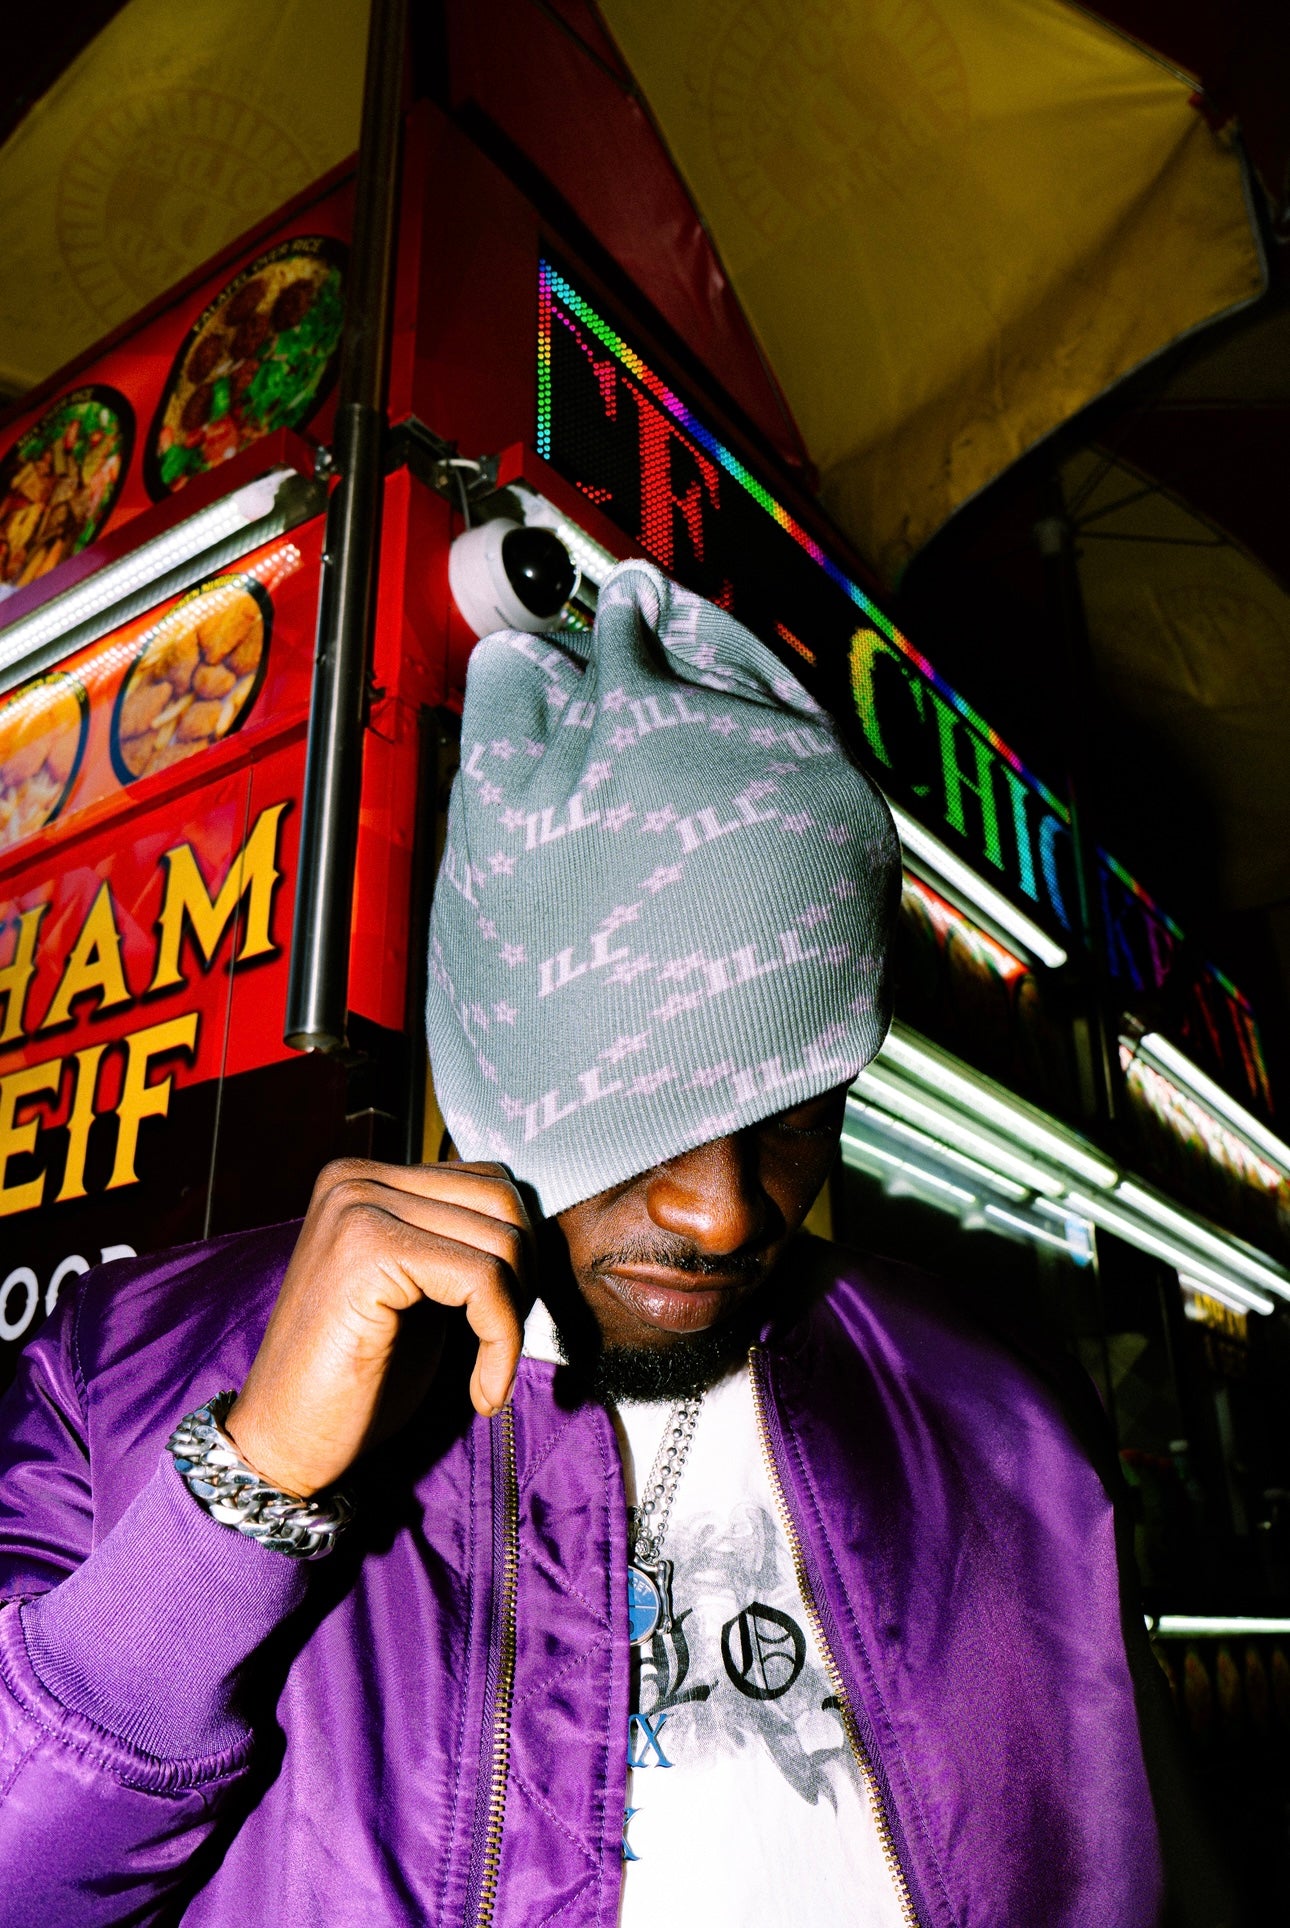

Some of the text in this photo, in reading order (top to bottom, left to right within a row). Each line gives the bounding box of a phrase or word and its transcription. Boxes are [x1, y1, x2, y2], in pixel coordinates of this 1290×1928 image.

[626, 690, 708, 737] ILL
[523, 791, 602, 851] ILL
[674, 793, 778, 855] ILL
[538, 930, 630, 998] ILL
[701, 930, 820, 997] ILL
[0, 1013, 198, 1217] EIF
[523, 1065, 624, 1143] ILL
